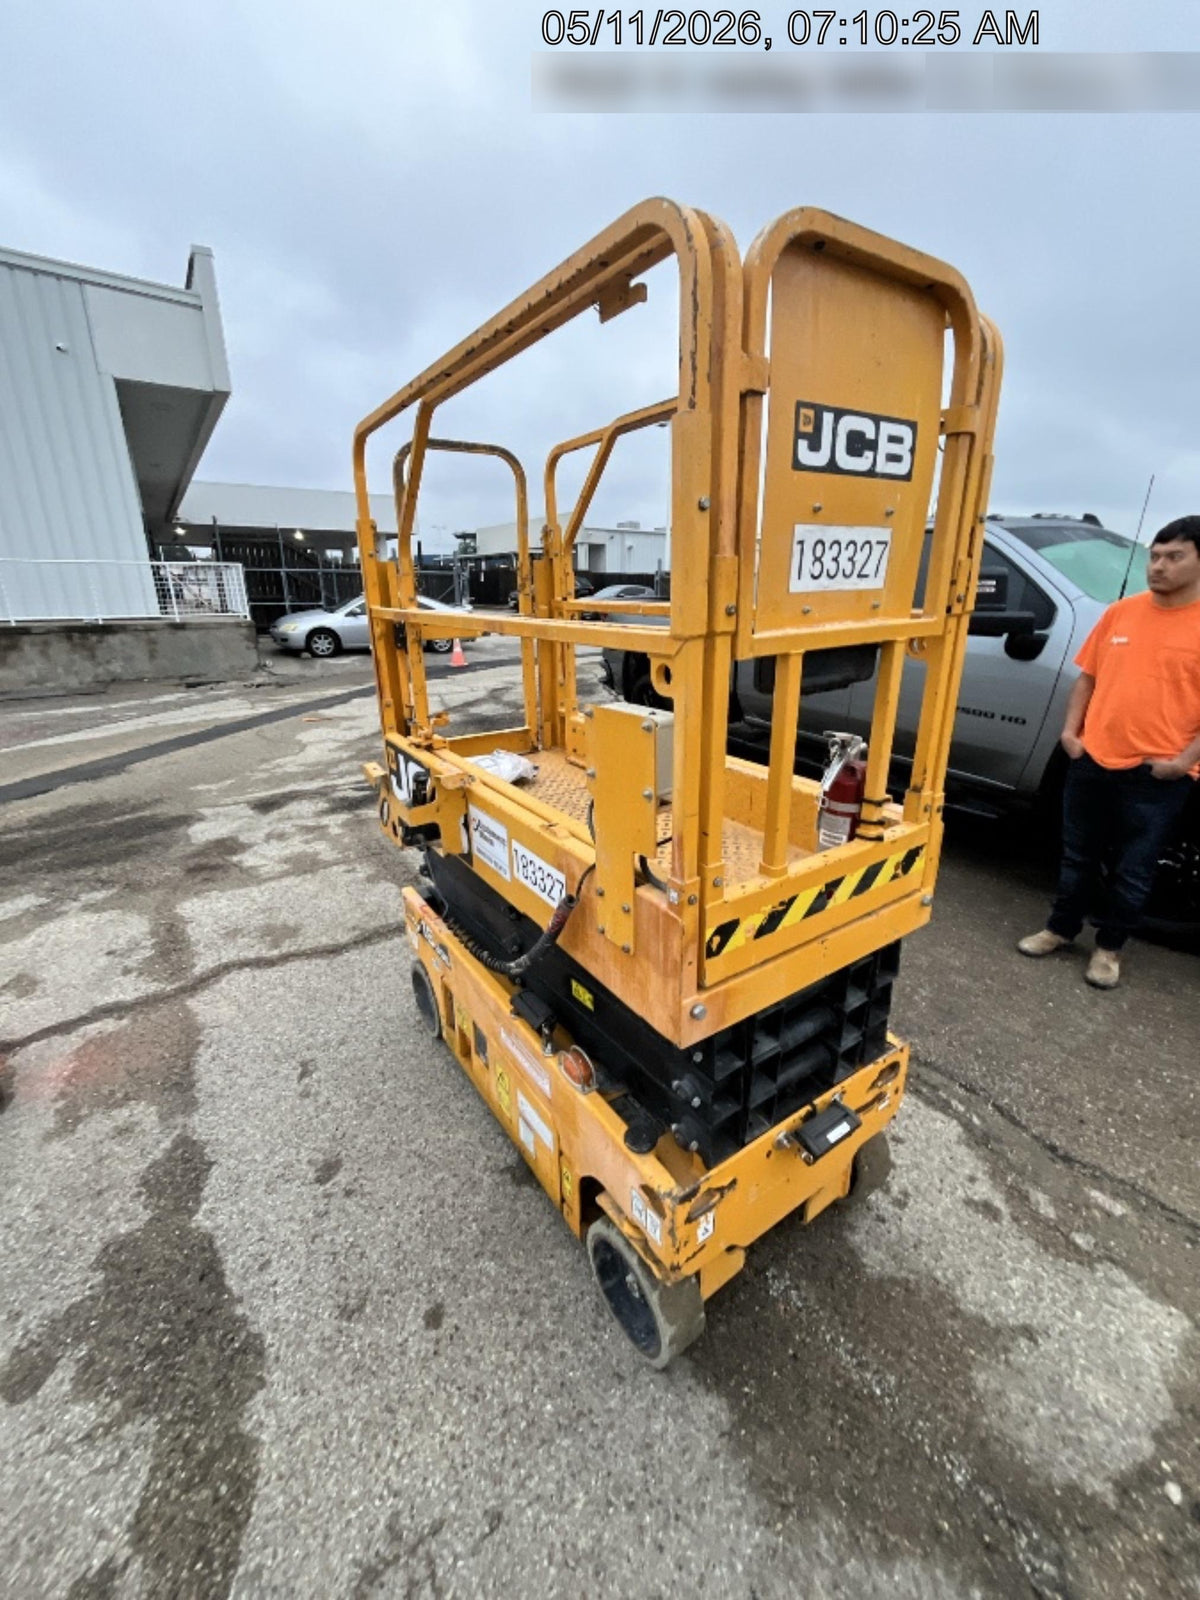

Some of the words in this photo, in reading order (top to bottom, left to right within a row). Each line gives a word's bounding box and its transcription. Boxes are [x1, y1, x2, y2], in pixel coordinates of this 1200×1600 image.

[797, 411, 914, 475] JCB
[796, 540, 888, 580] 183327
[513, 848, 565, 903] 183327
